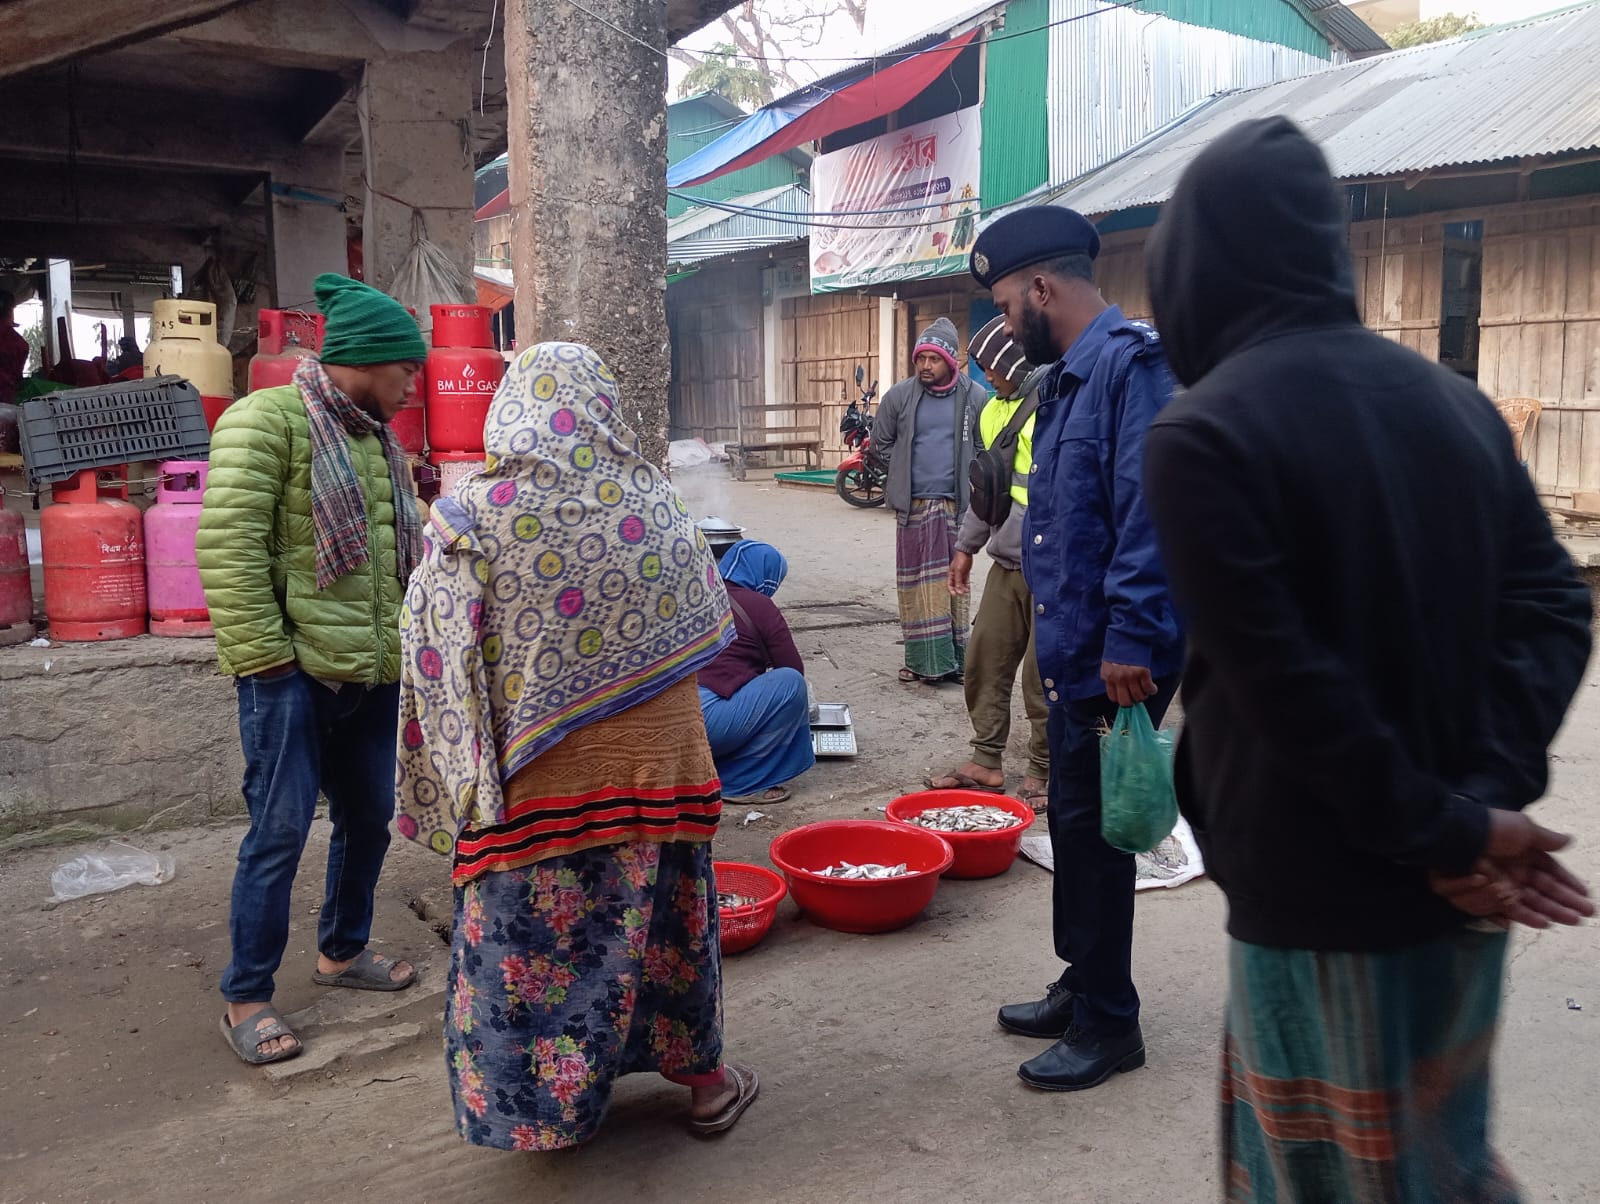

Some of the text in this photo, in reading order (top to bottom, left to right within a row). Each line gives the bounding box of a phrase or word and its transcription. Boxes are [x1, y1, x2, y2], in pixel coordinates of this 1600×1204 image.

[437, 380, 497, 391] BM LP GAS
